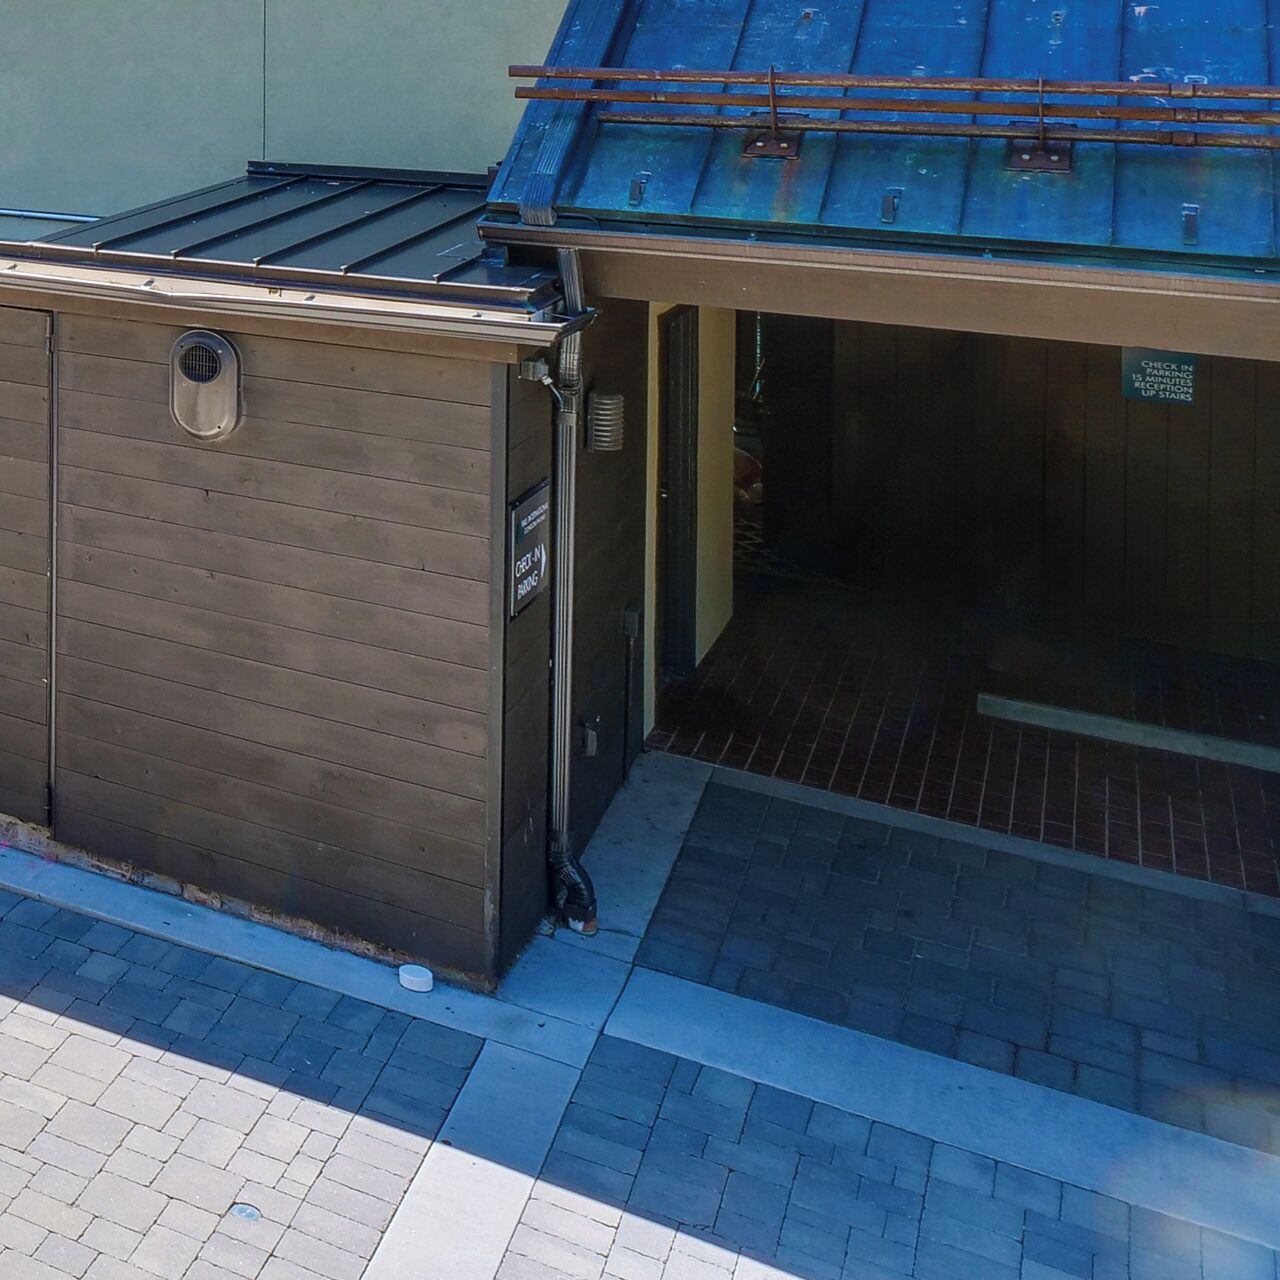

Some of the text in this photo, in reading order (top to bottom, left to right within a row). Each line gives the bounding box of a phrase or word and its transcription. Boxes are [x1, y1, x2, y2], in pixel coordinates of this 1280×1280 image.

[1141, 360, 1193, 372] CHECK IN
[1146, 368, 1193, 379] PARKING
[1132, 373, 1193, 388] 15 MINUTES
[1134, 381, 1193, 394] RECEPTION
[1141, 389, 1192, 402] UP STAIRS
